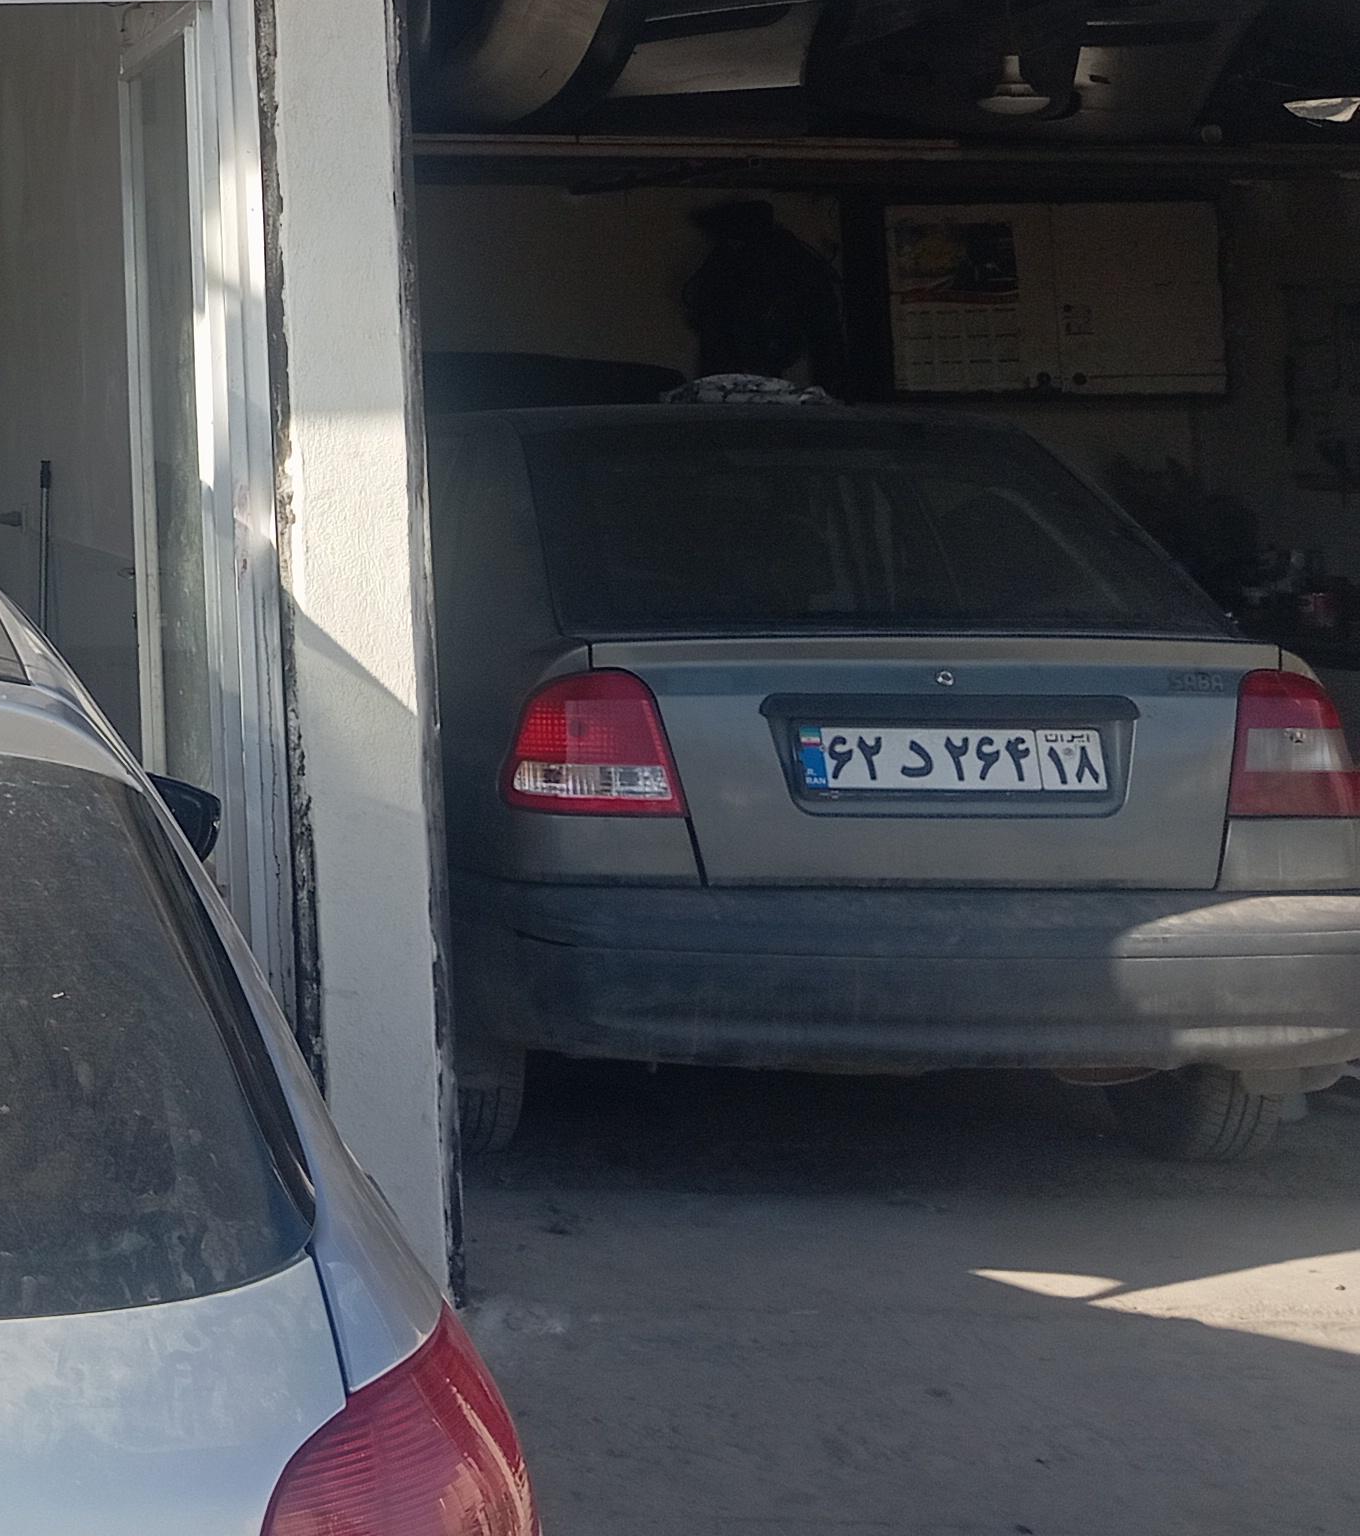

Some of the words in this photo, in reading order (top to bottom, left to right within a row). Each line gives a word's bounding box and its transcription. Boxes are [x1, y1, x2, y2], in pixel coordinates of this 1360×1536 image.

[828, 735, 882, 782] ۶۲
[944, 735, 1031, 782] ۲۶۴
[1047, 745, 1100, 785] ۱۸
